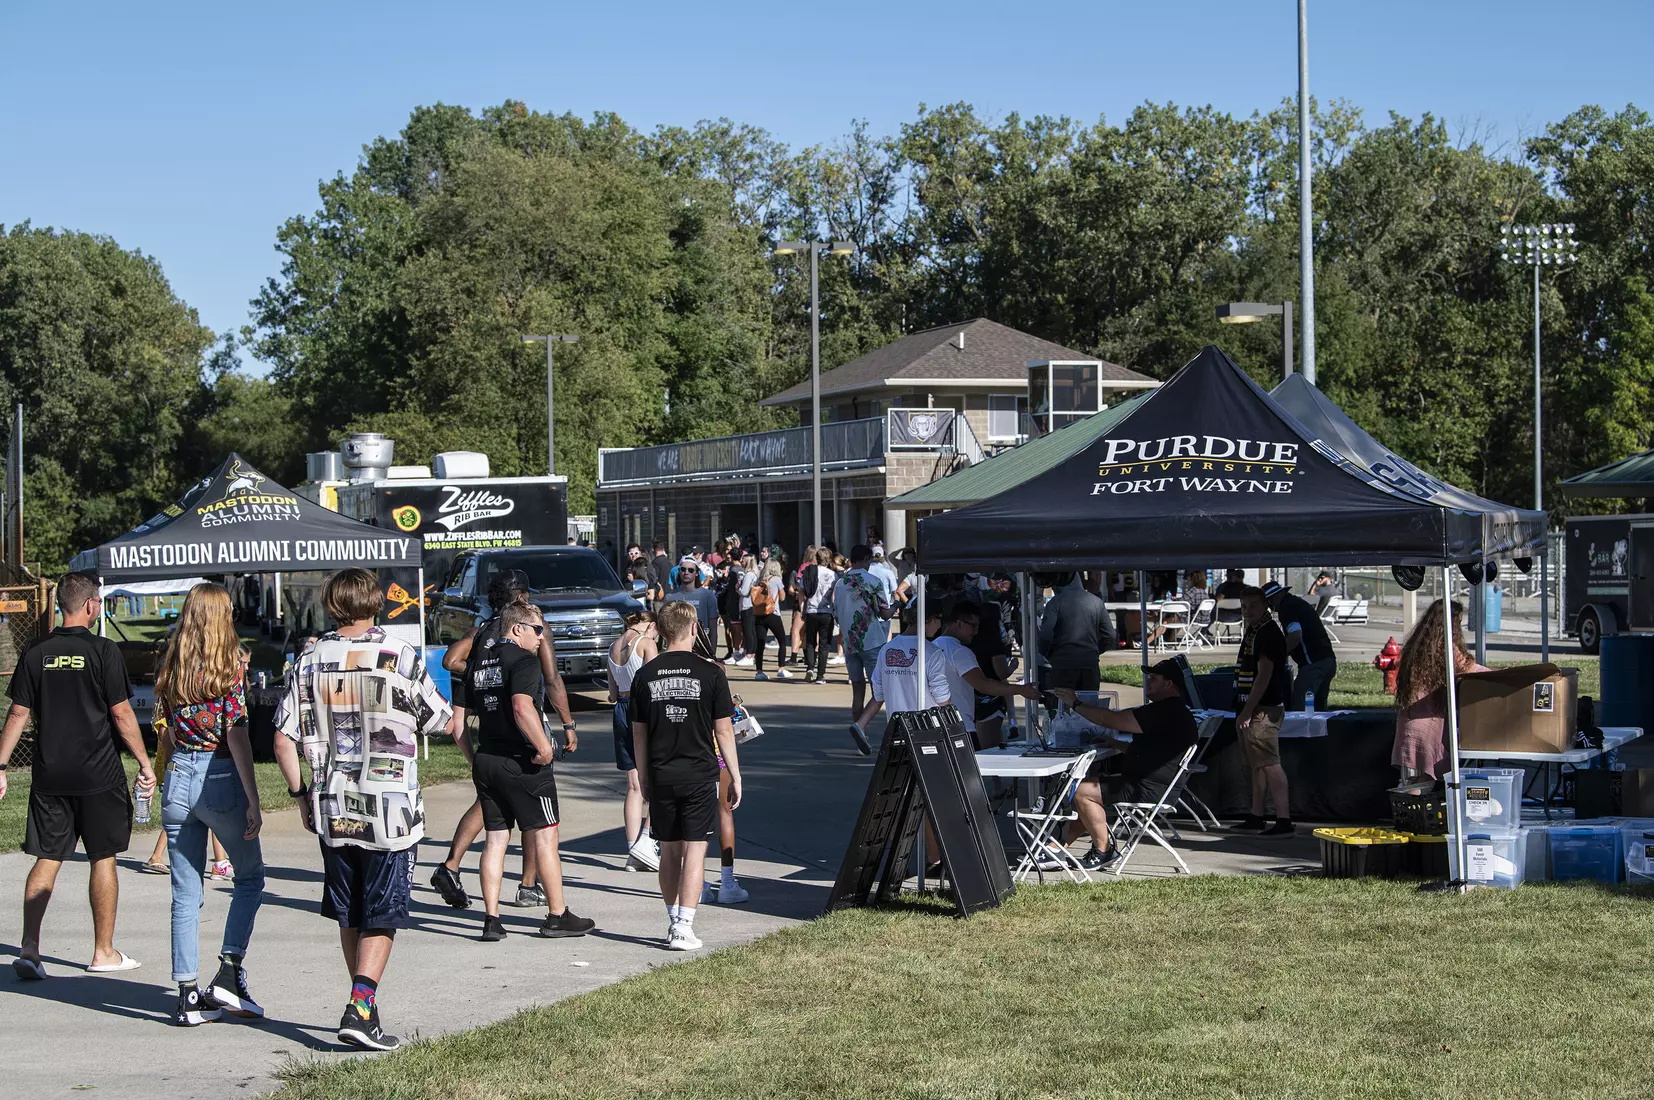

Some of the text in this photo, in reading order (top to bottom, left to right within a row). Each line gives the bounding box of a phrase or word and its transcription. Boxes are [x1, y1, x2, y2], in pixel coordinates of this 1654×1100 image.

[760, 436, 786, 462] WAYNE
[1100, 435, 1299, 465] PURDUE
[1100, 461, 1295, 476] UNIVERSITY
[1090, 477, 1293, 496] FORT WAYNE
[197, 496, 297, 515] MASTODON
[438, 486, 503, 513] Ziffles
[201, 505, 300, 522] ALUMNI
[201, 514, 301, 528] COMMUNITY
[454, 513, 471, 525] RIB
[110, 538, 409, 569] MASTODON ALUMNI COMMUNITY
[441, 541, 456, 549] EAST
[1597, 553, 1610, 564] BAR
[648, 677, 701, 698] WHITES
